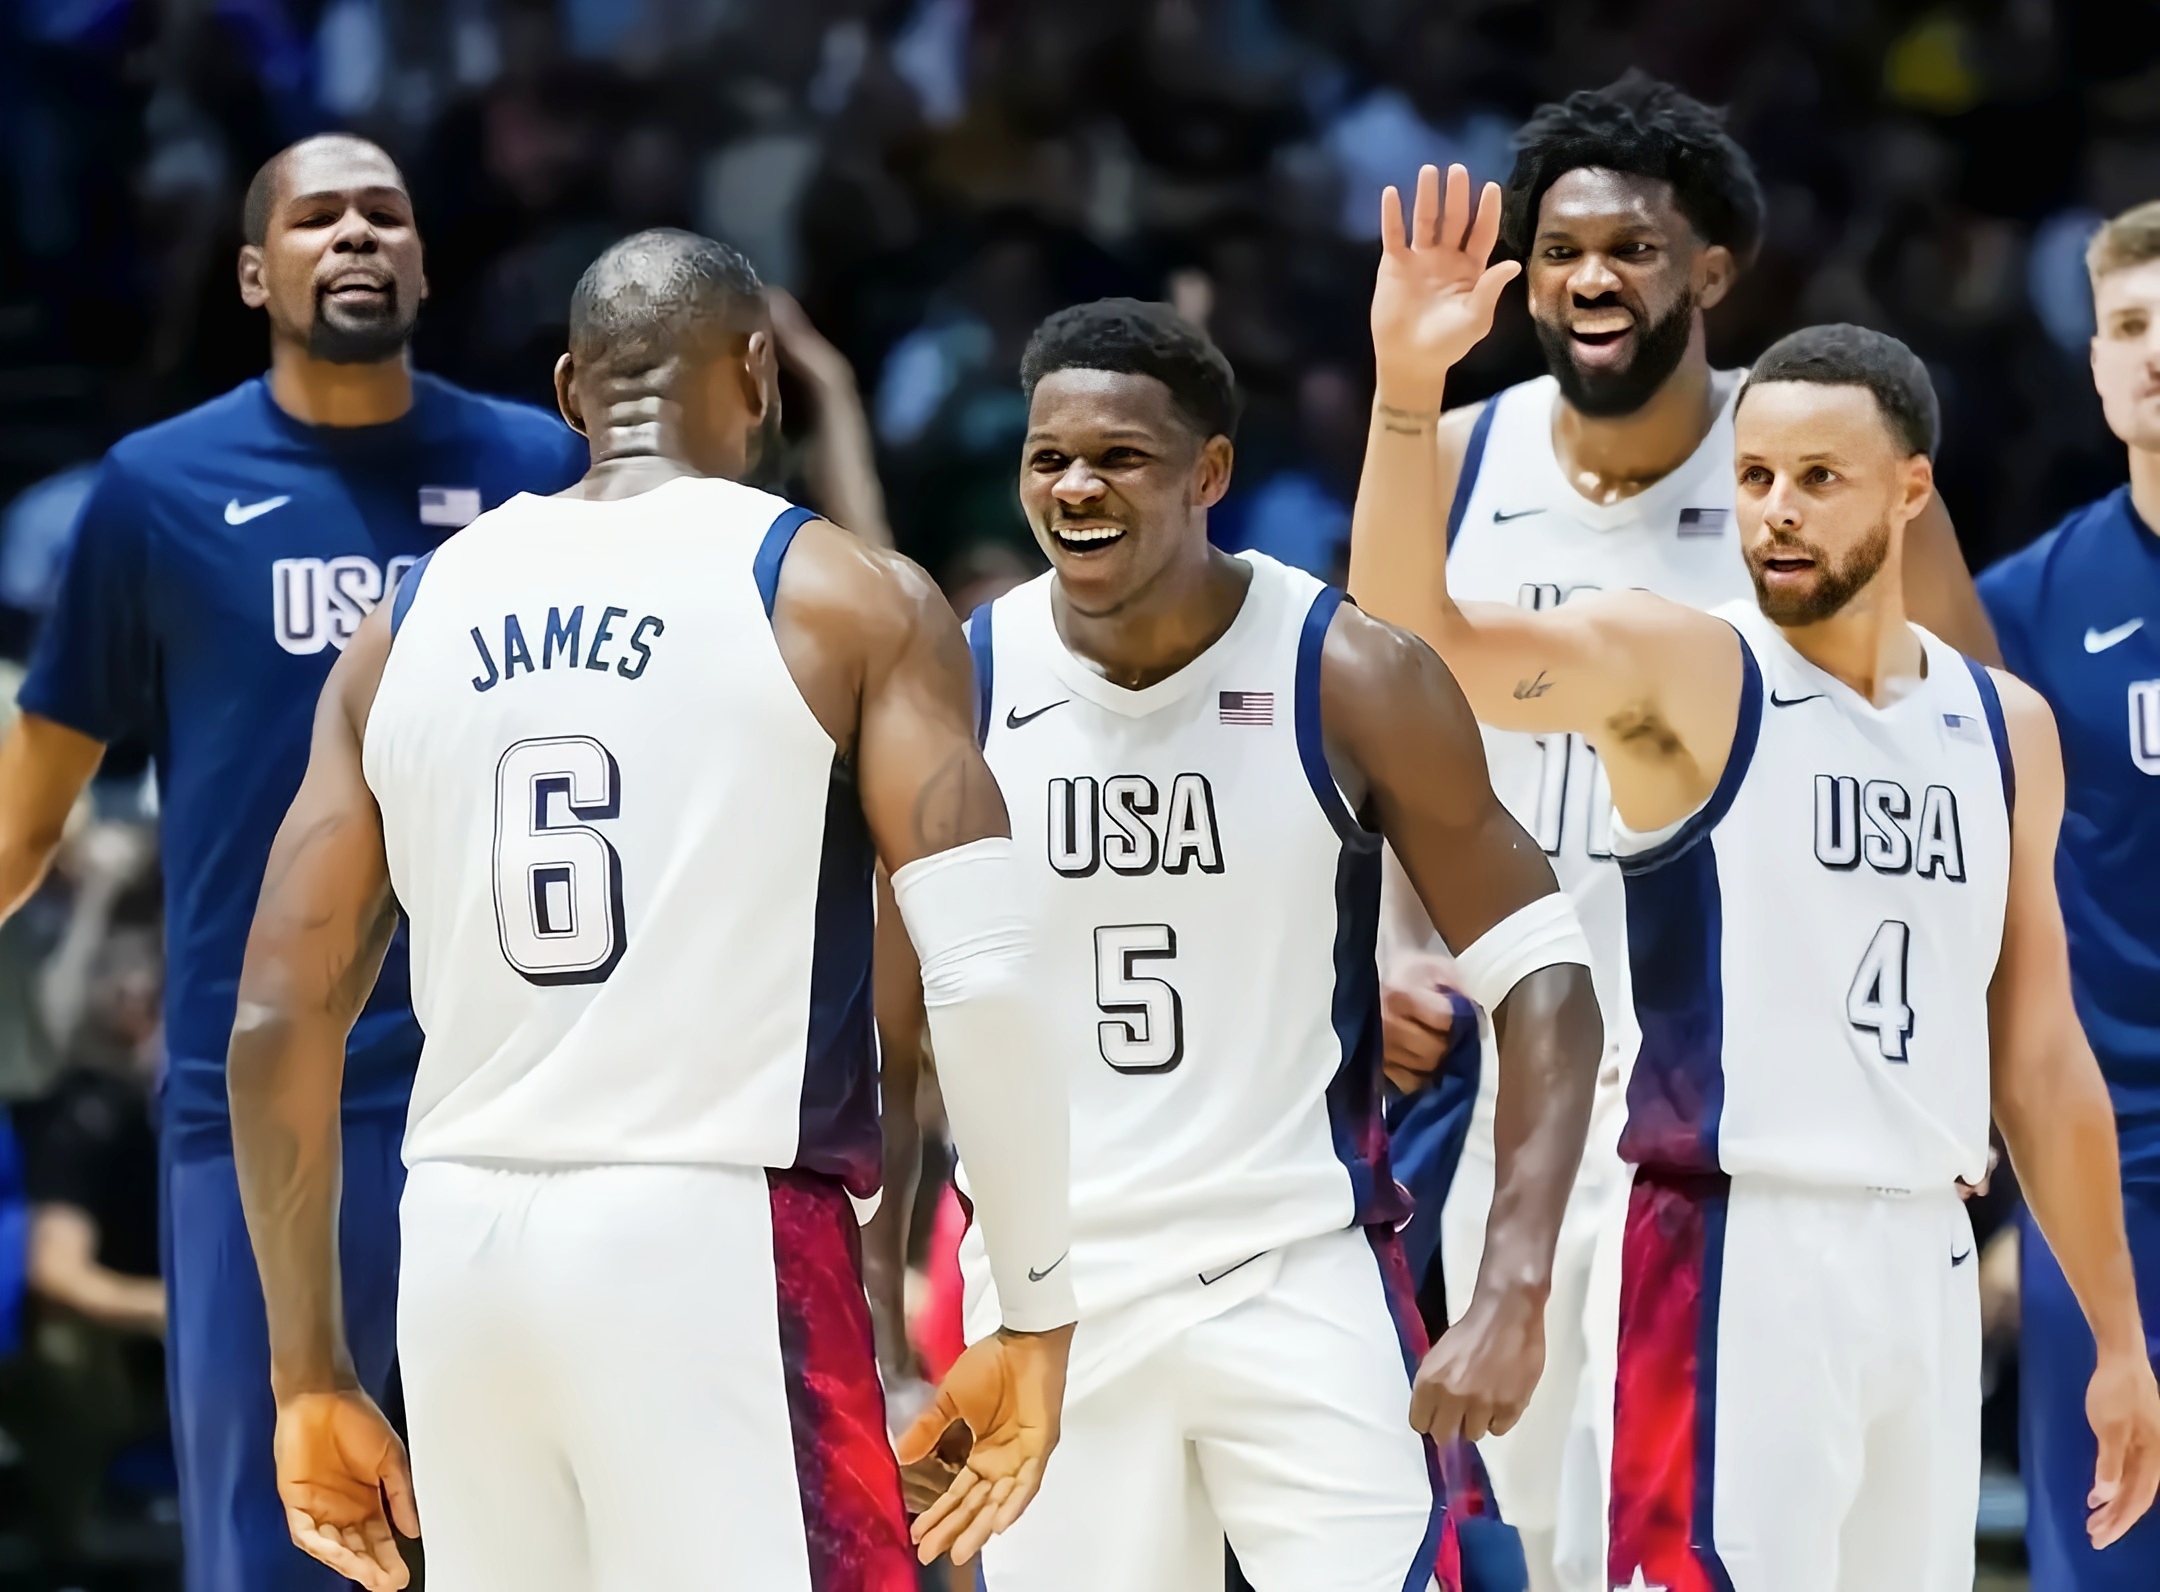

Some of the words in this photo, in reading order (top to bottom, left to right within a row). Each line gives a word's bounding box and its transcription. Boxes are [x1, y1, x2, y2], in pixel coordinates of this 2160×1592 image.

[272, 555, 417, 655] US
[470, 605, 665, 692] JAMES
[492, 735, 628, 987] 6
[1048, 772, 1226, 879] USA
[1814, 774, 1967, 884] USA
[1094, 923, 1184, 1075] 5
[1846, 919, 1915, 1065] 4
